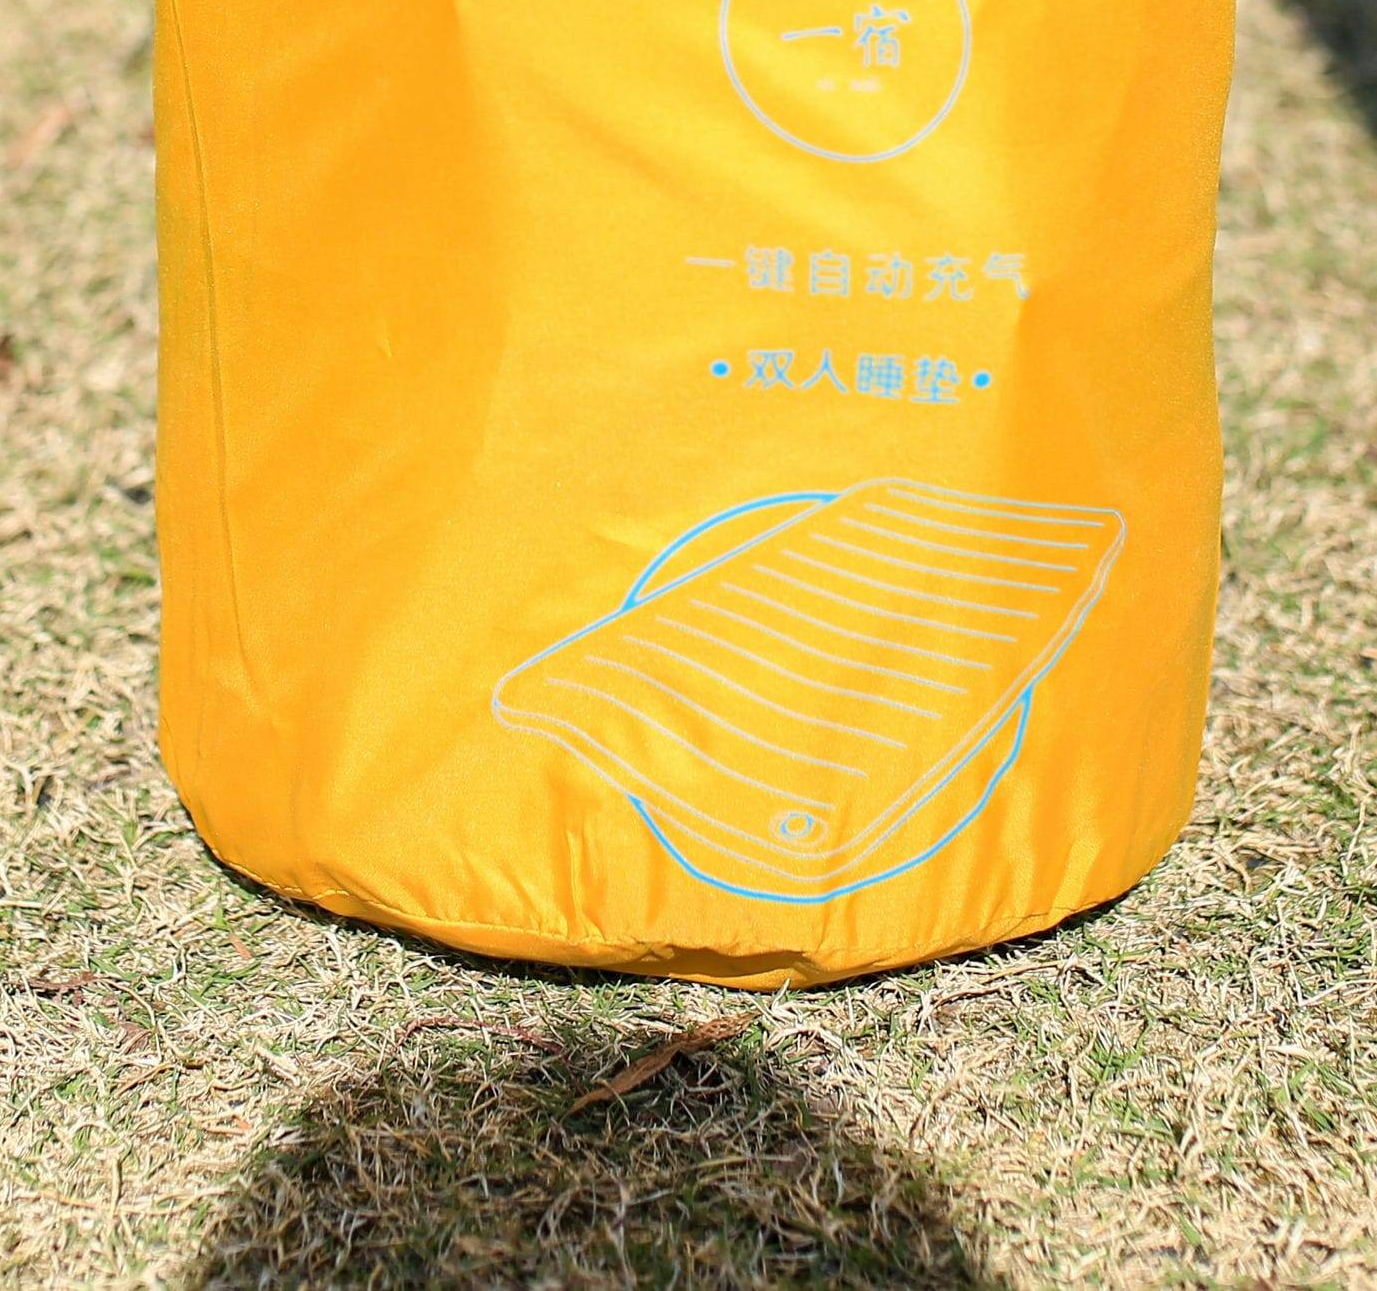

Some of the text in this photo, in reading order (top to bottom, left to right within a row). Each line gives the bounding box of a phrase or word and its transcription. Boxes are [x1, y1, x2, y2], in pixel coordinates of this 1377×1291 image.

[780, 3, 911, 69] 一宿
[685, 245, 1031, 300] 一键自动充气
